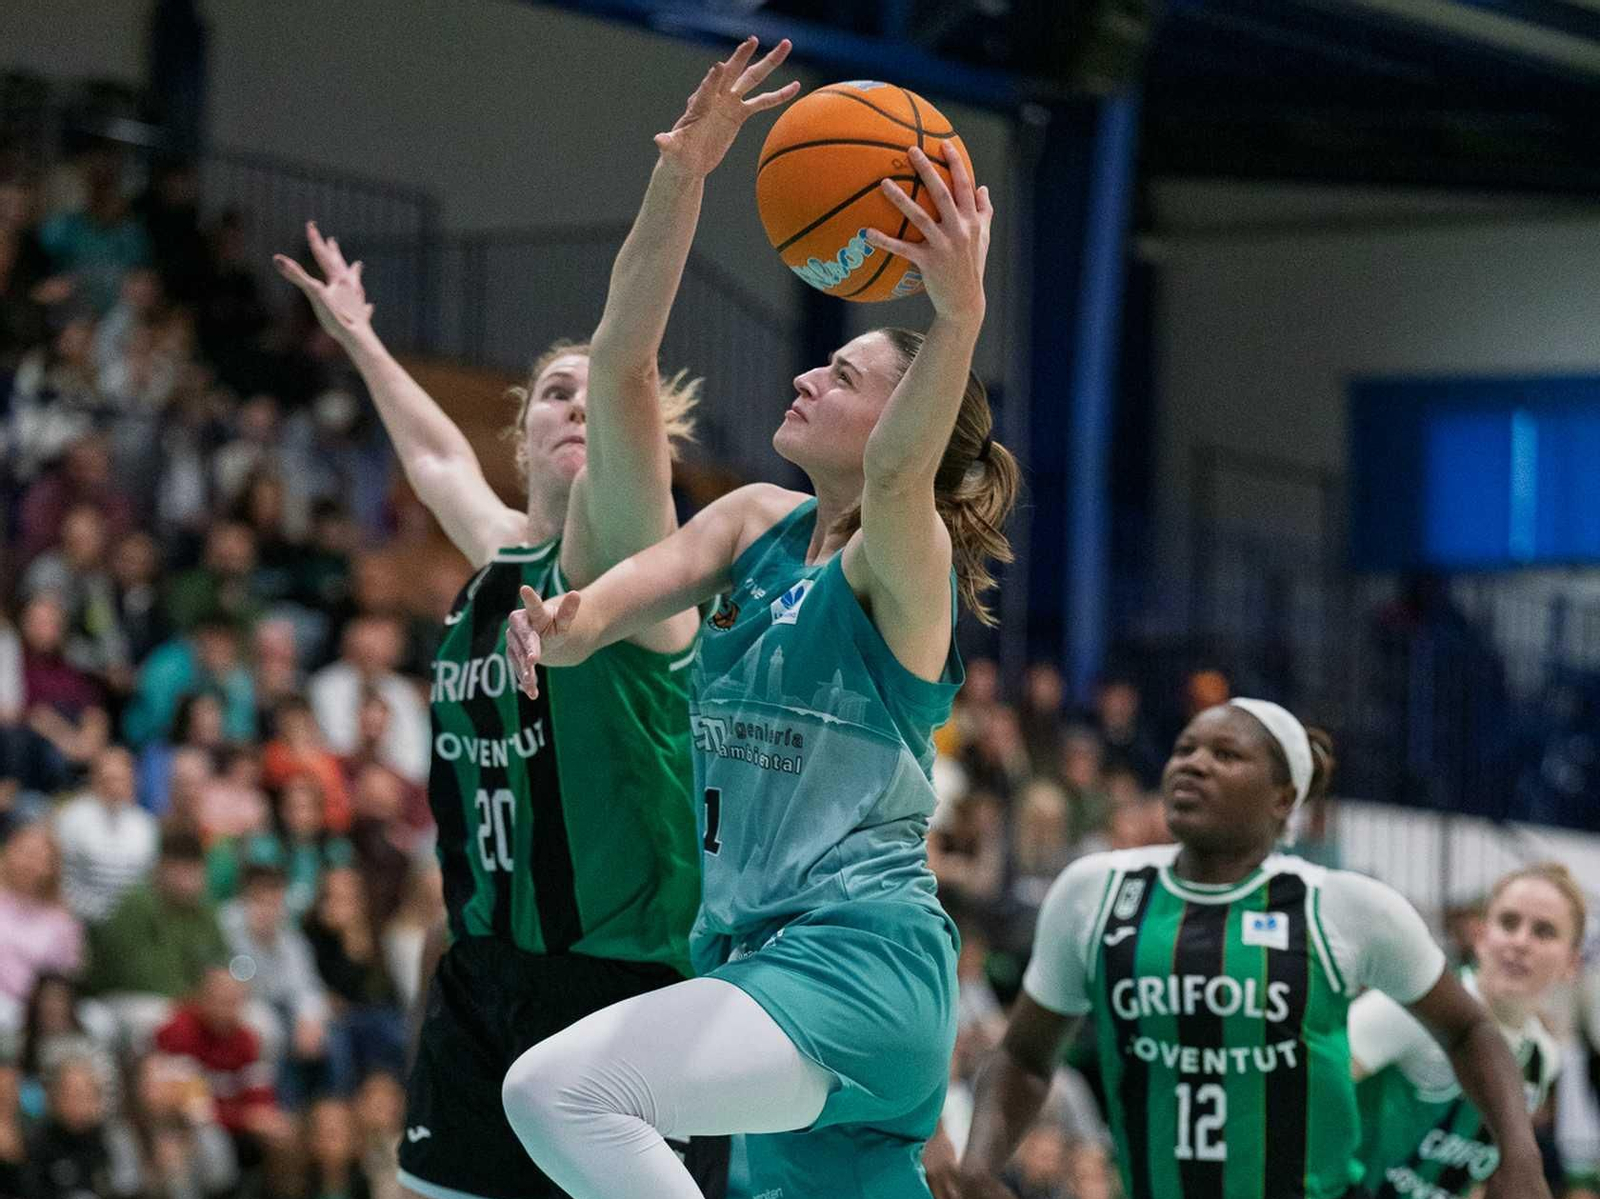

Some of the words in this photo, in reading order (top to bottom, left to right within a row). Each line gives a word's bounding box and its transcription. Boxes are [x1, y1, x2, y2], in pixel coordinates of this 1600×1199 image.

[474, 788, 516, 871] 20
[1112, 974, 1291, 1023] GRIFOLS
[1132, 1036, 1298, 1076] OVENTUT
[1174, 1082, 1228, 1162] 12
